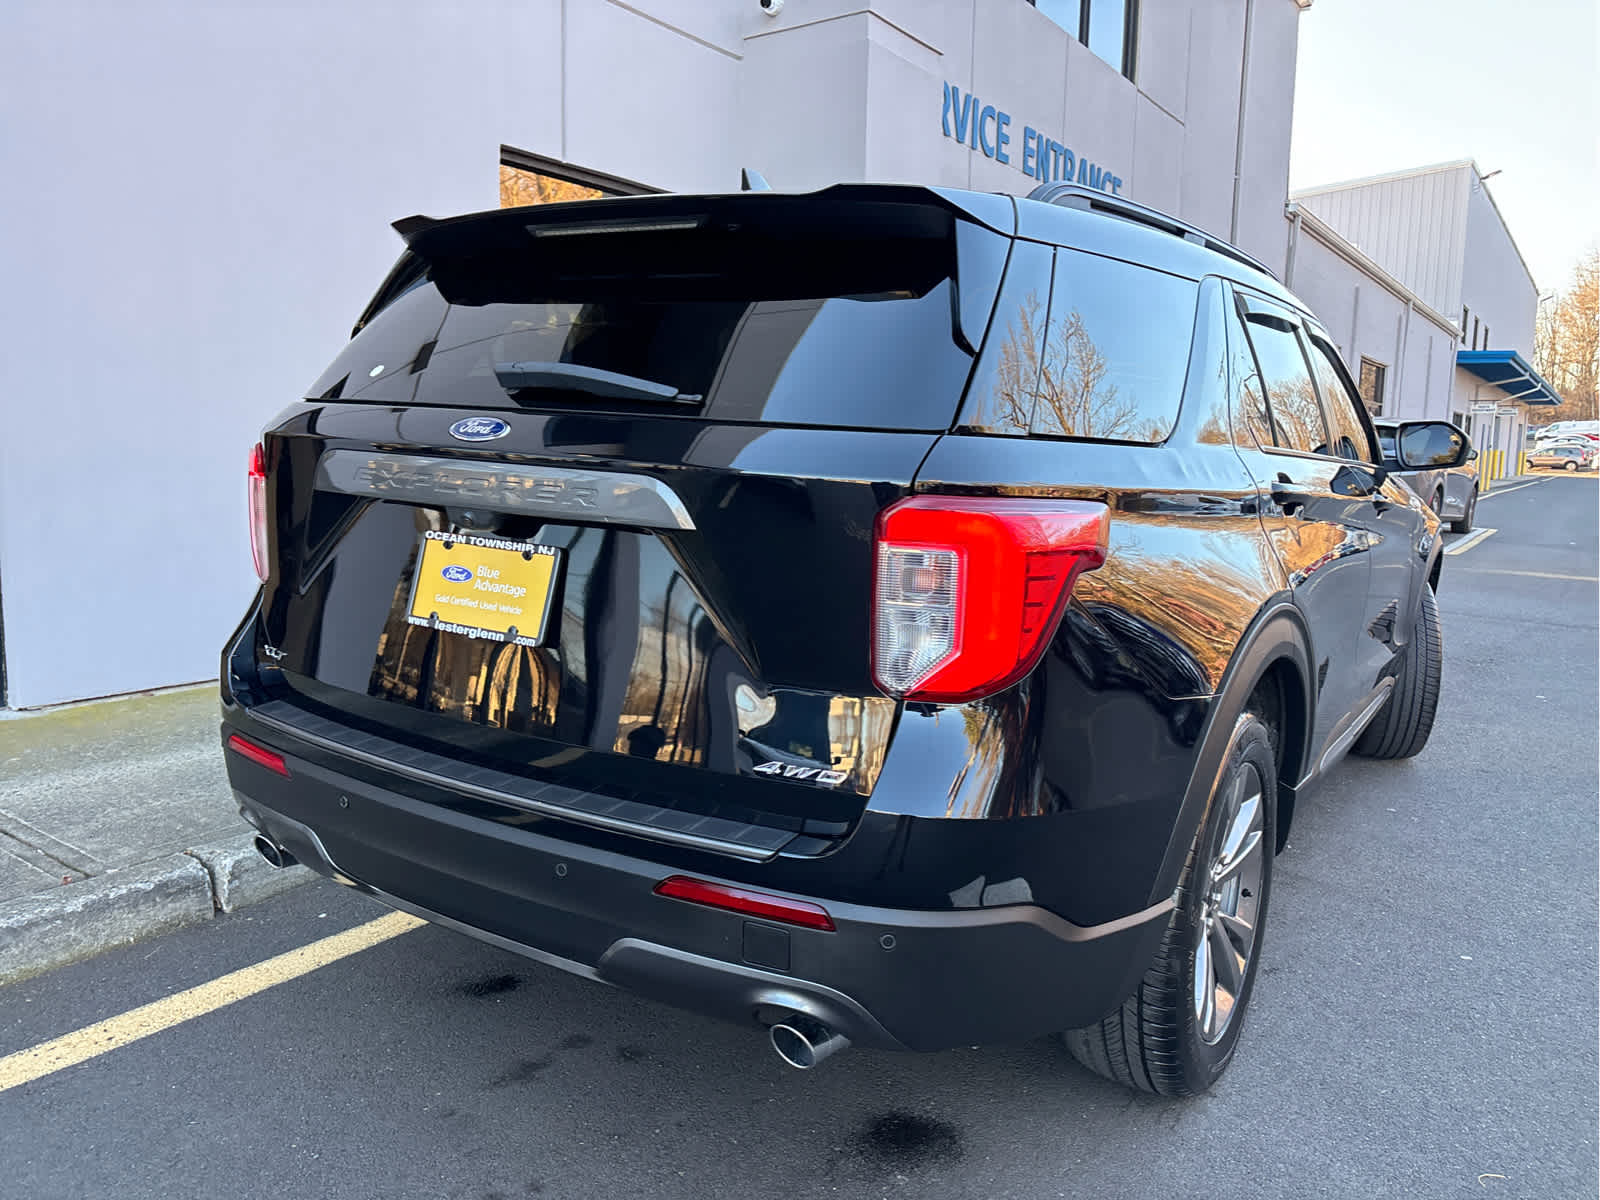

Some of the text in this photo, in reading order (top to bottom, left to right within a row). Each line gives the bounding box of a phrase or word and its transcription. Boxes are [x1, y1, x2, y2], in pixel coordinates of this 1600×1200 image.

[425, 530, 466, 544] OCEAN
[537, 545, 556, 556] NJ
[477, 565, 500, 579] Blue
[473, 578, 527, 598] Advantage
[479, 600, 497, 611] Used
[434, 620, 505, 641] lesterglenn
[753, 761, 848, 784] 4WD
